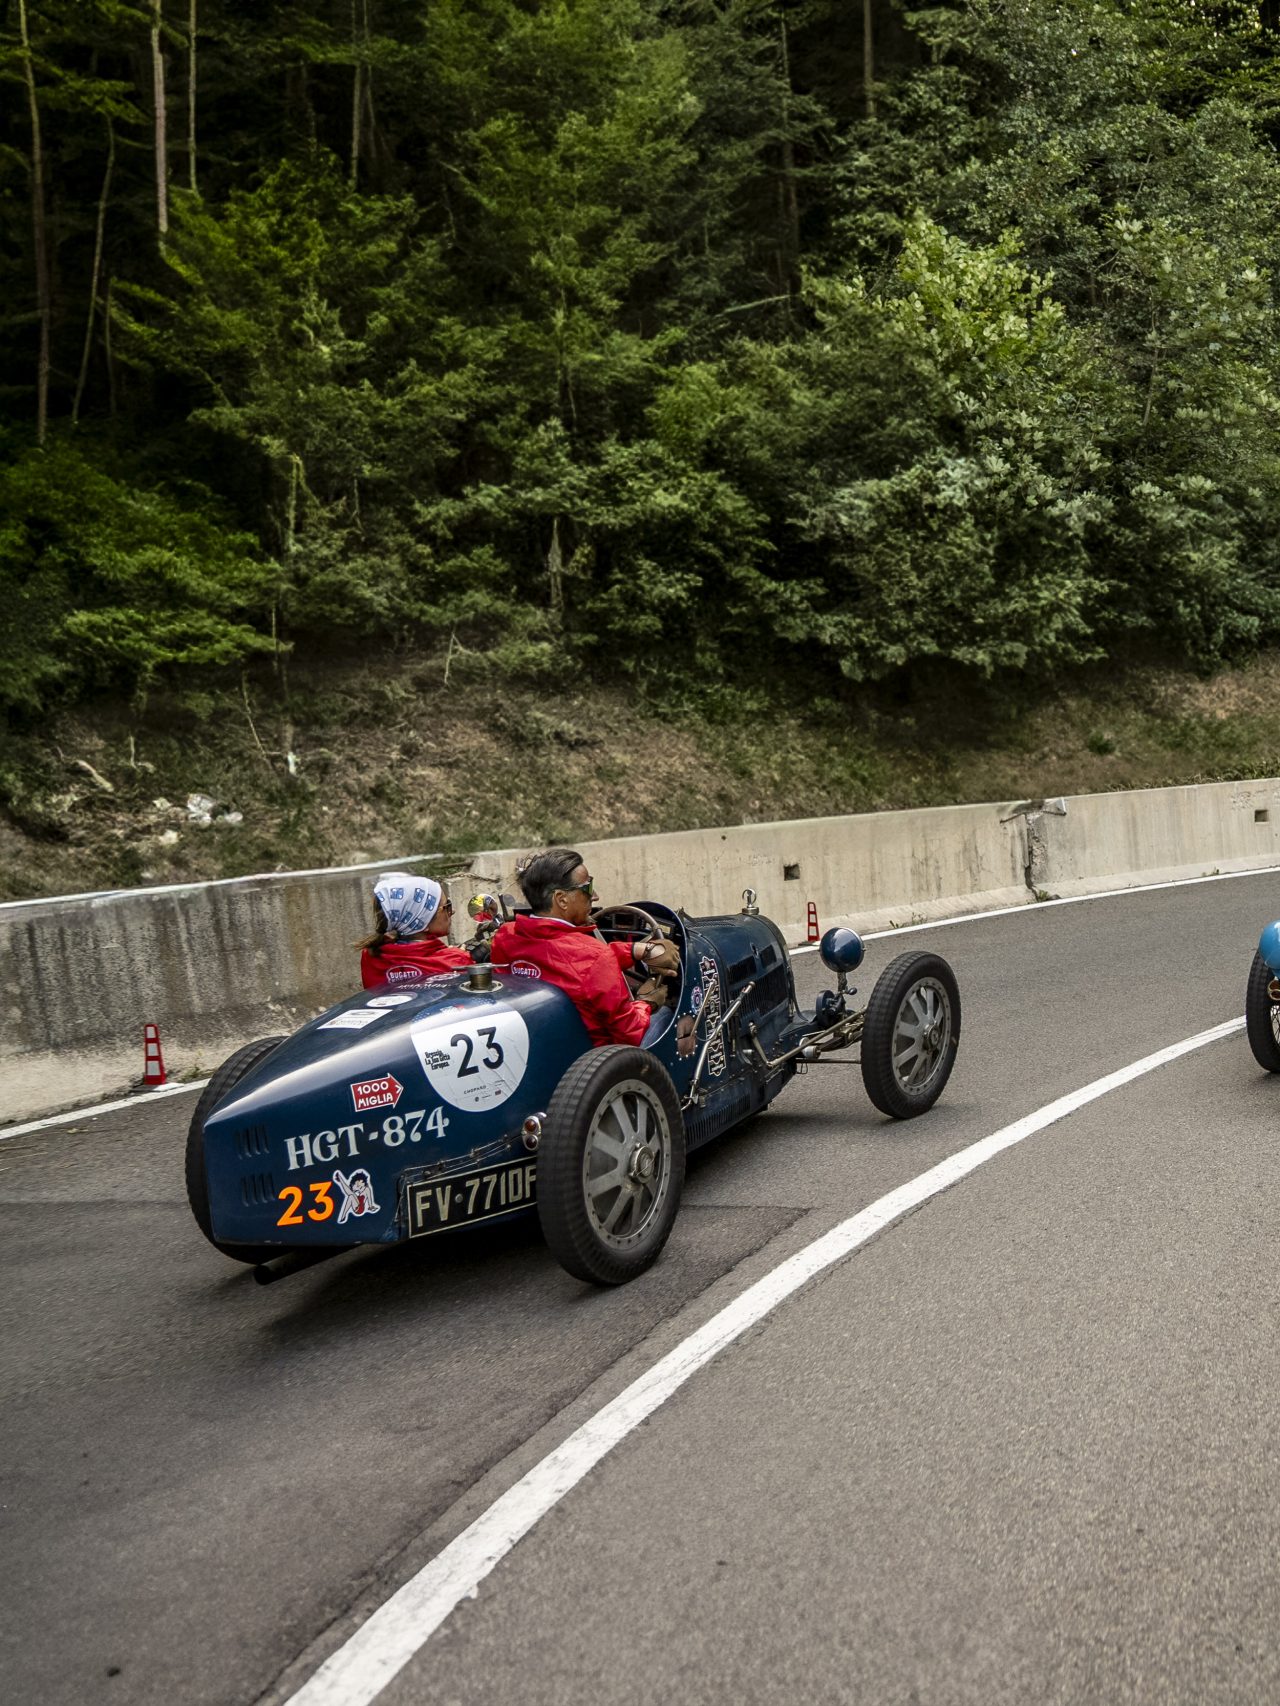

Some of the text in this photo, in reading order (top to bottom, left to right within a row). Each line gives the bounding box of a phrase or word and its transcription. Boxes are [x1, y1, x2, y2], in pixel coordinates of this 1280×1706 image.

[389, 970, 418, 980] BUGATTI
[514, 967, 538, 977] BUGATTI
[450, 1026, 504, 1078] 23
[357, 1081, 389, 1095] 1000
[358, 1093, 393, 1108] MIGLIA
[284, 1106, 450, 1170] HGT-874
[276, 1181, 335, 1226] 23
